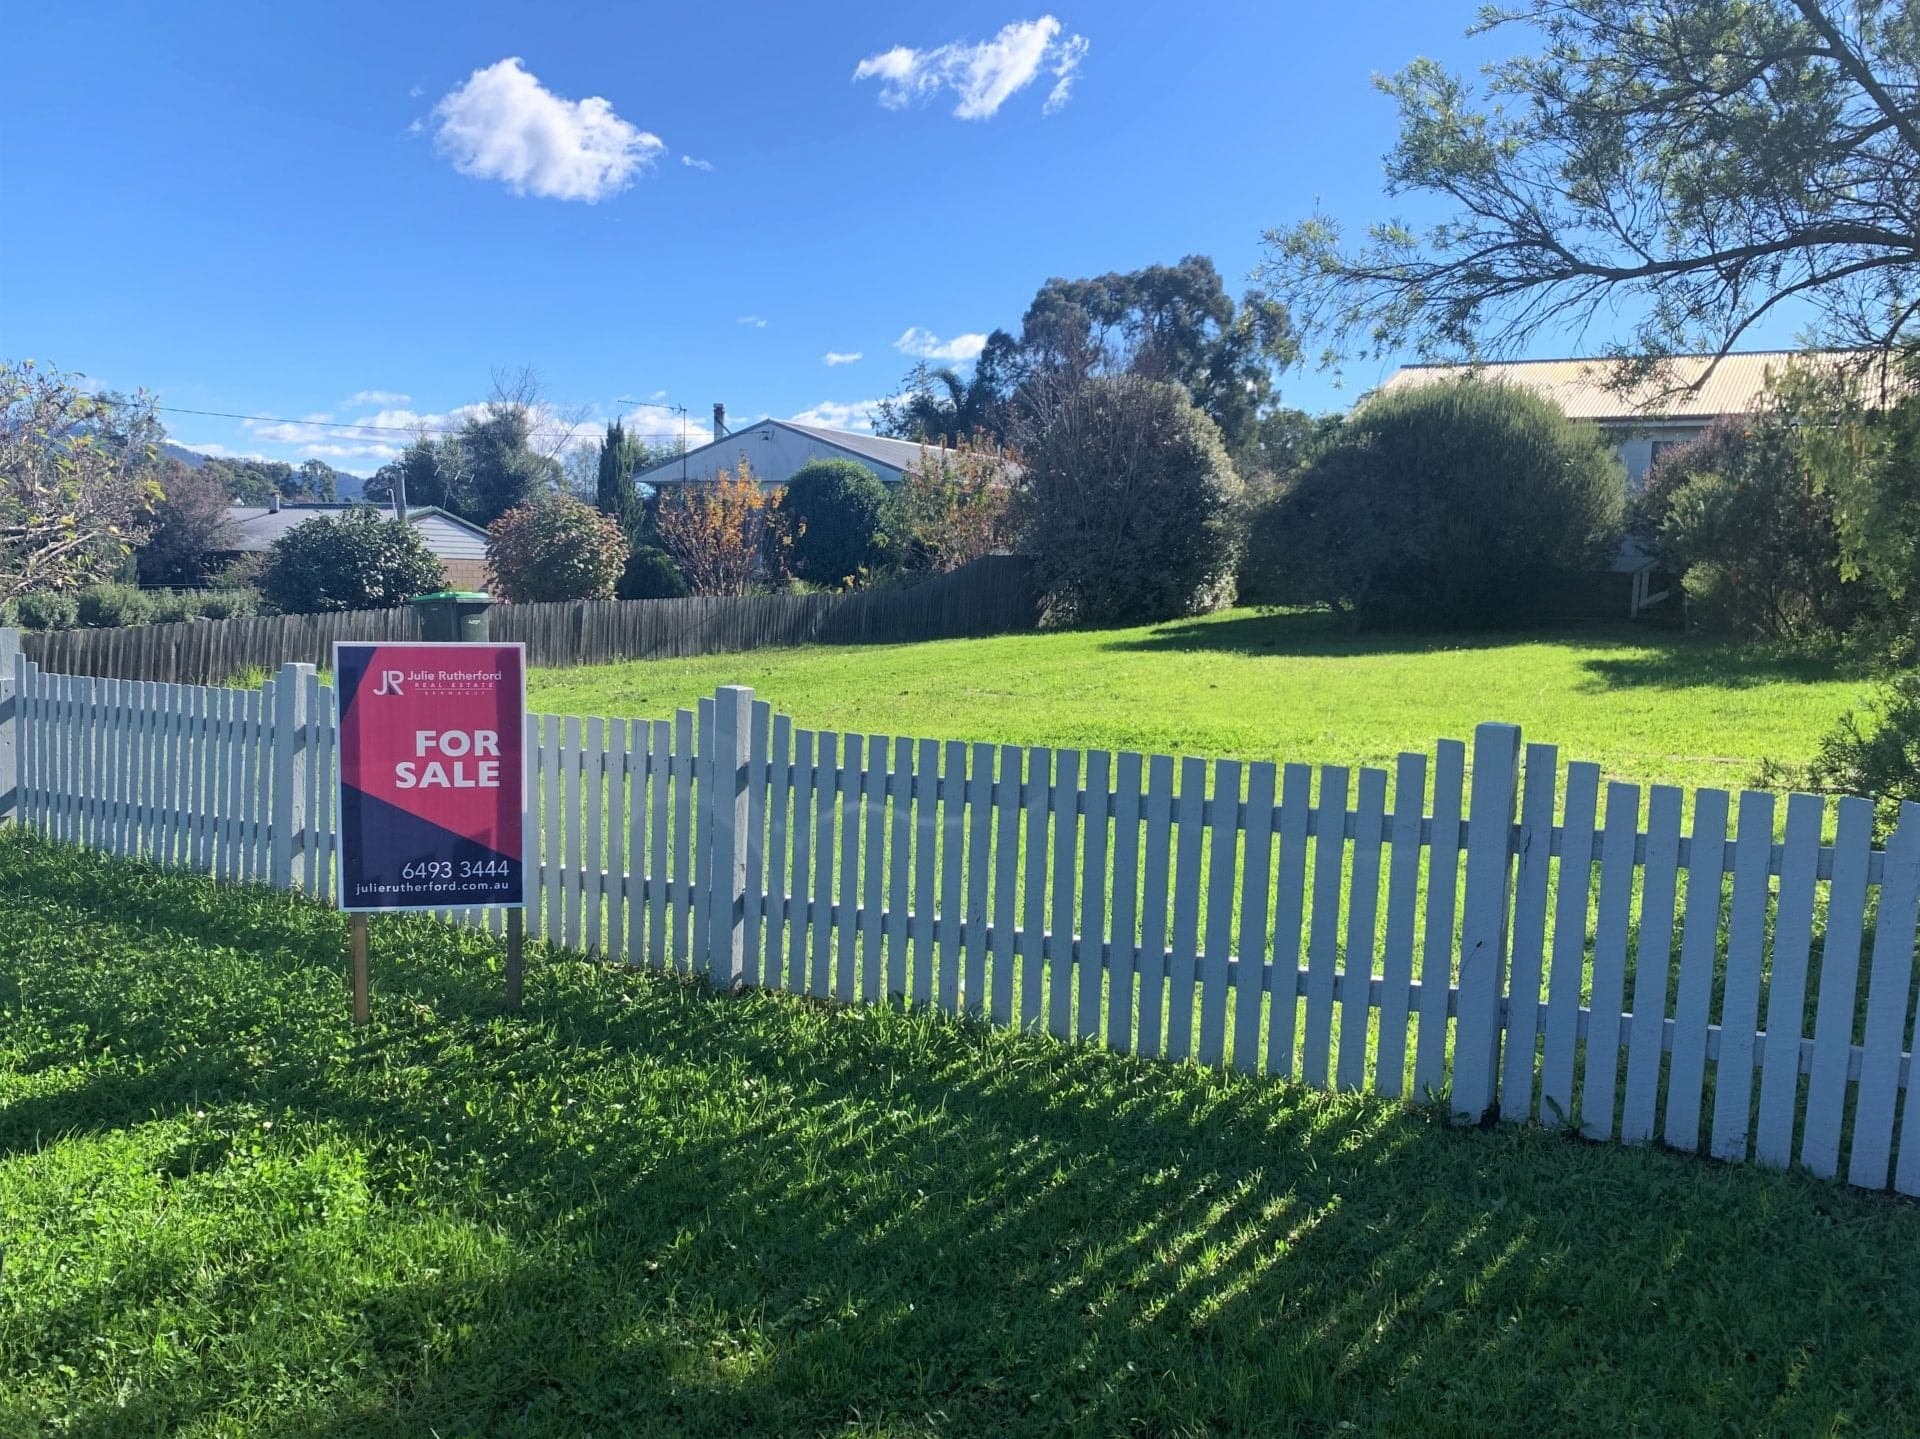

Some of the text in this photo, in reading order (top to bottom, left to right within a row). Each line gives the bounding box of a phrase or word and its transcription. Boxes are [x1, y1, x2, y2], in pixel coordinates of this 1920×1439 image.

[373, 671, 404, 696] JR
[407, 670, 502, 681] Julie Rutherford
[416, 730, 501, 757] FOR
[395, 761, 500, 788] SALE
[402, 860, 509, 879] 6493 3444
[355, 881, 509, 895] julierutherford.com.au
